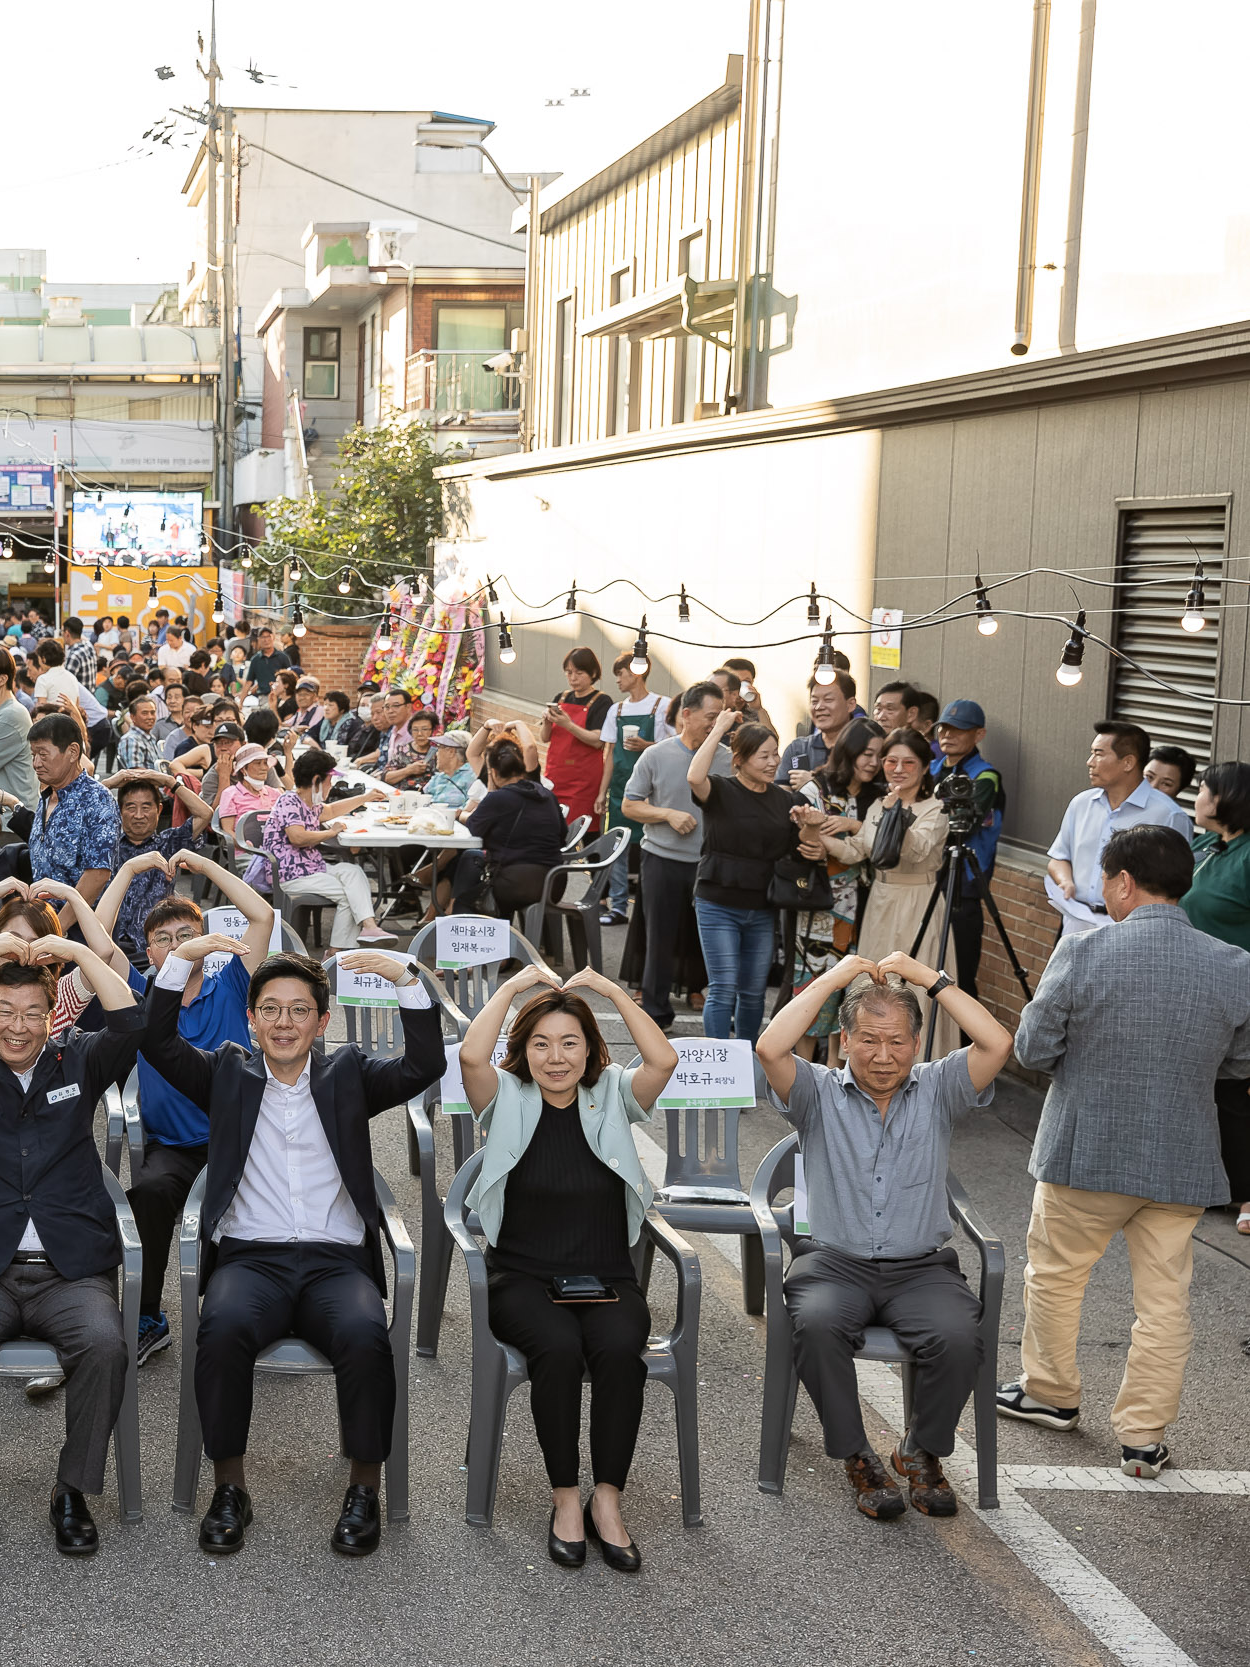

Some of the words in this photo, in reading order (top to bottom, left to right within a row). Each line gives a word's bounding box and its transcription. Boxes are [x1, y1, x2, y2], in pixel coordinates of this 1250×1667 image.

[450, 925, 496, 937] 새마을시장
[451, 942, 479, 953] 임재복
[353, 976, 382, 988] 최규철
[679, 1048, 729, 1063] 자양시장
[676, 1072, 713, 1086] 박호규
